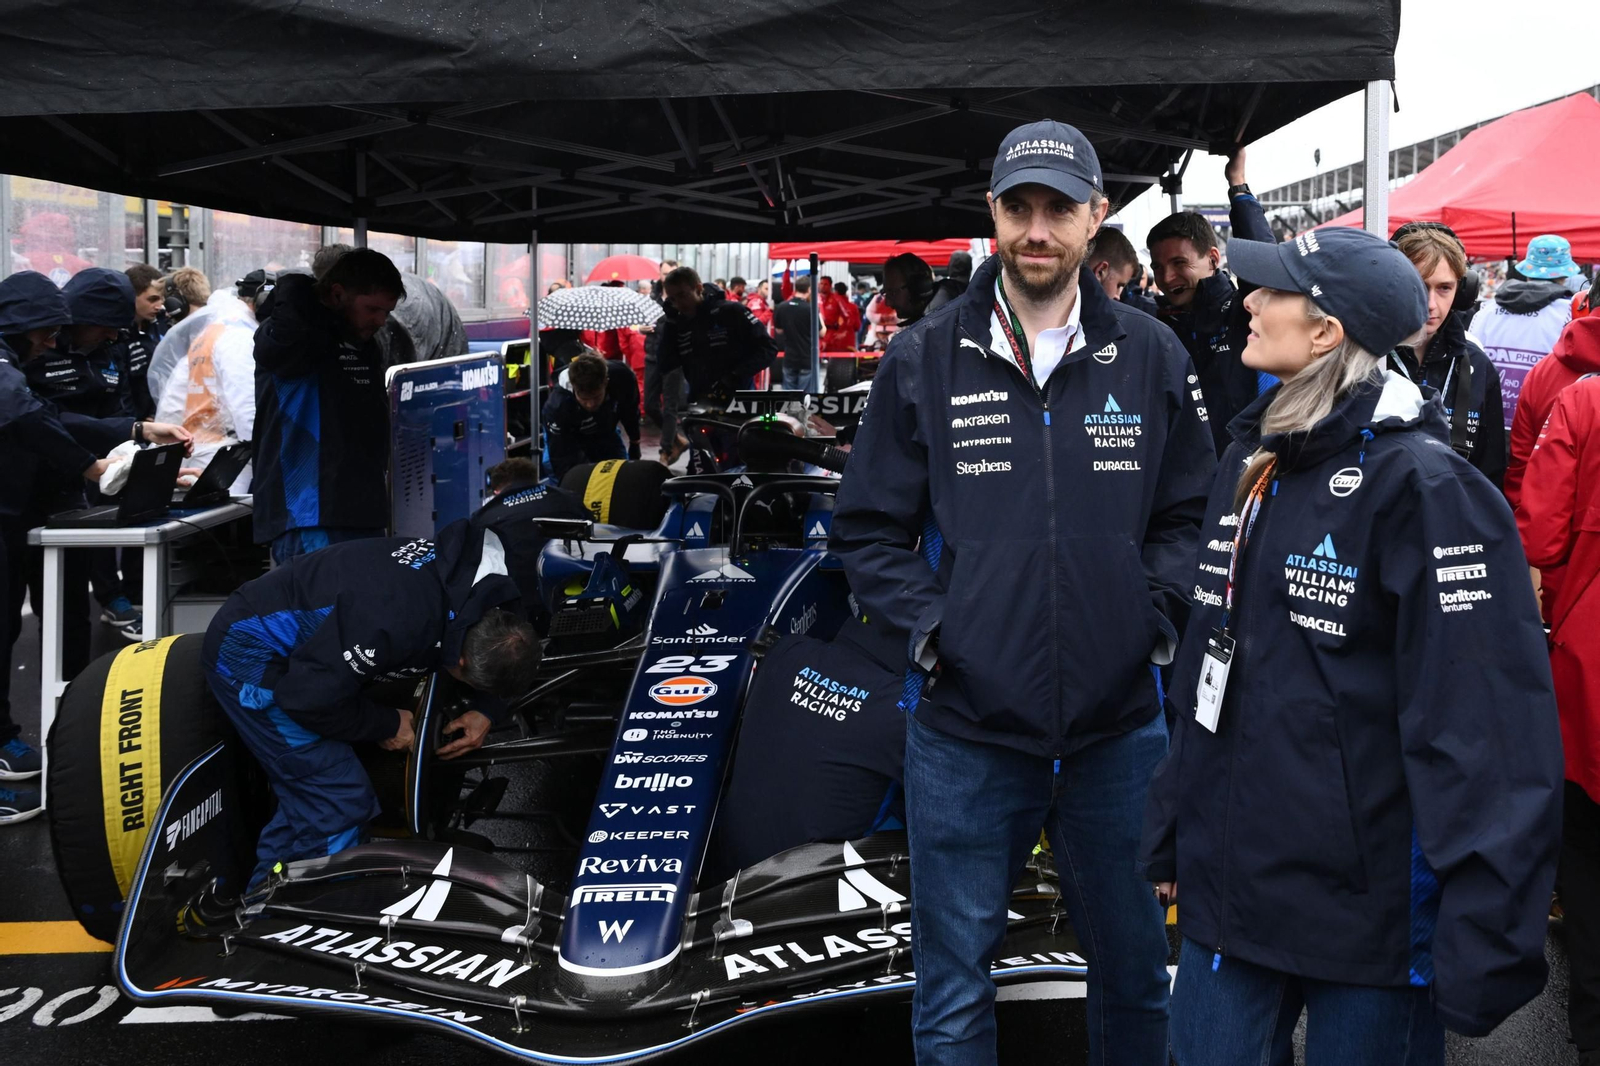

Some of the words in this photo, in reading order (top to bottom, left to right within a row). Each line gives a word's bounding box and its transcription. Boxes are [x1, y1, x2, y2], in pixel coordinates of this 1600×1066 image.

[1006, 148, 1042, 161] WILLIAMS
[1043, 148, 1074, 159] RACING
[1014, 140, 1074, 153] ATLASSIAN
[462, 361, 499, 391] KOMATSU
[400, 381, 414, 402] 23
[951, 390, 1008, 406] KOMATSU
[1084, 414, 1142, 424] ATLASSIAN
[1085, 426, 1142, 436] WILLIAMS
[962, 437, 1012, 448] MYPROTEIN
[1094, 438, 1136, 448] RACING
[956, 459, 1012, 476] Stephens
[1093, 460, 1141, 471] DURACELL
[1332, 476, 1361, 486] Gulf
[1442, 544, 1484, 556] KEEPER
[1284, 568, 1356, 594] WILLIAMS
[1436, 563, 1487, 582] PIRELLI
[1288, 583, 1348, 608] RACING
[1441, 602, 1473, 613] Ventures
[1290, 610, 1346, 636] DURACELL
[652, 636, 746, 644] Santander
[354, 644, 376, 667] Santander
[644, 655, 738, 674] 23
[654, 686, 713, 695] Gulf
[793, 676, 862, 712] WILLIAMS
[629, 708, 719, 720] KOMATSU
[790, 691, 846, 722] RACING
[118, 688, 144, 754] FRONT
[614, 773, 694, 792] brillio
[119, 762, 145, 832] RIGHT
[182, 788, 222, 841] FANCAPITAL
[631, 806, 696, 815] VAST
[610, 830, 690, 840] KEEPER
[578, 854, 682, 878] Reviva
[570, 883, 678, 908] PIRELLI
[598, 920, 634, 944] W
[260, 924, 532, 988] ATLASSIAN
[198, 978, 483, 1023] MYPROTEIN
